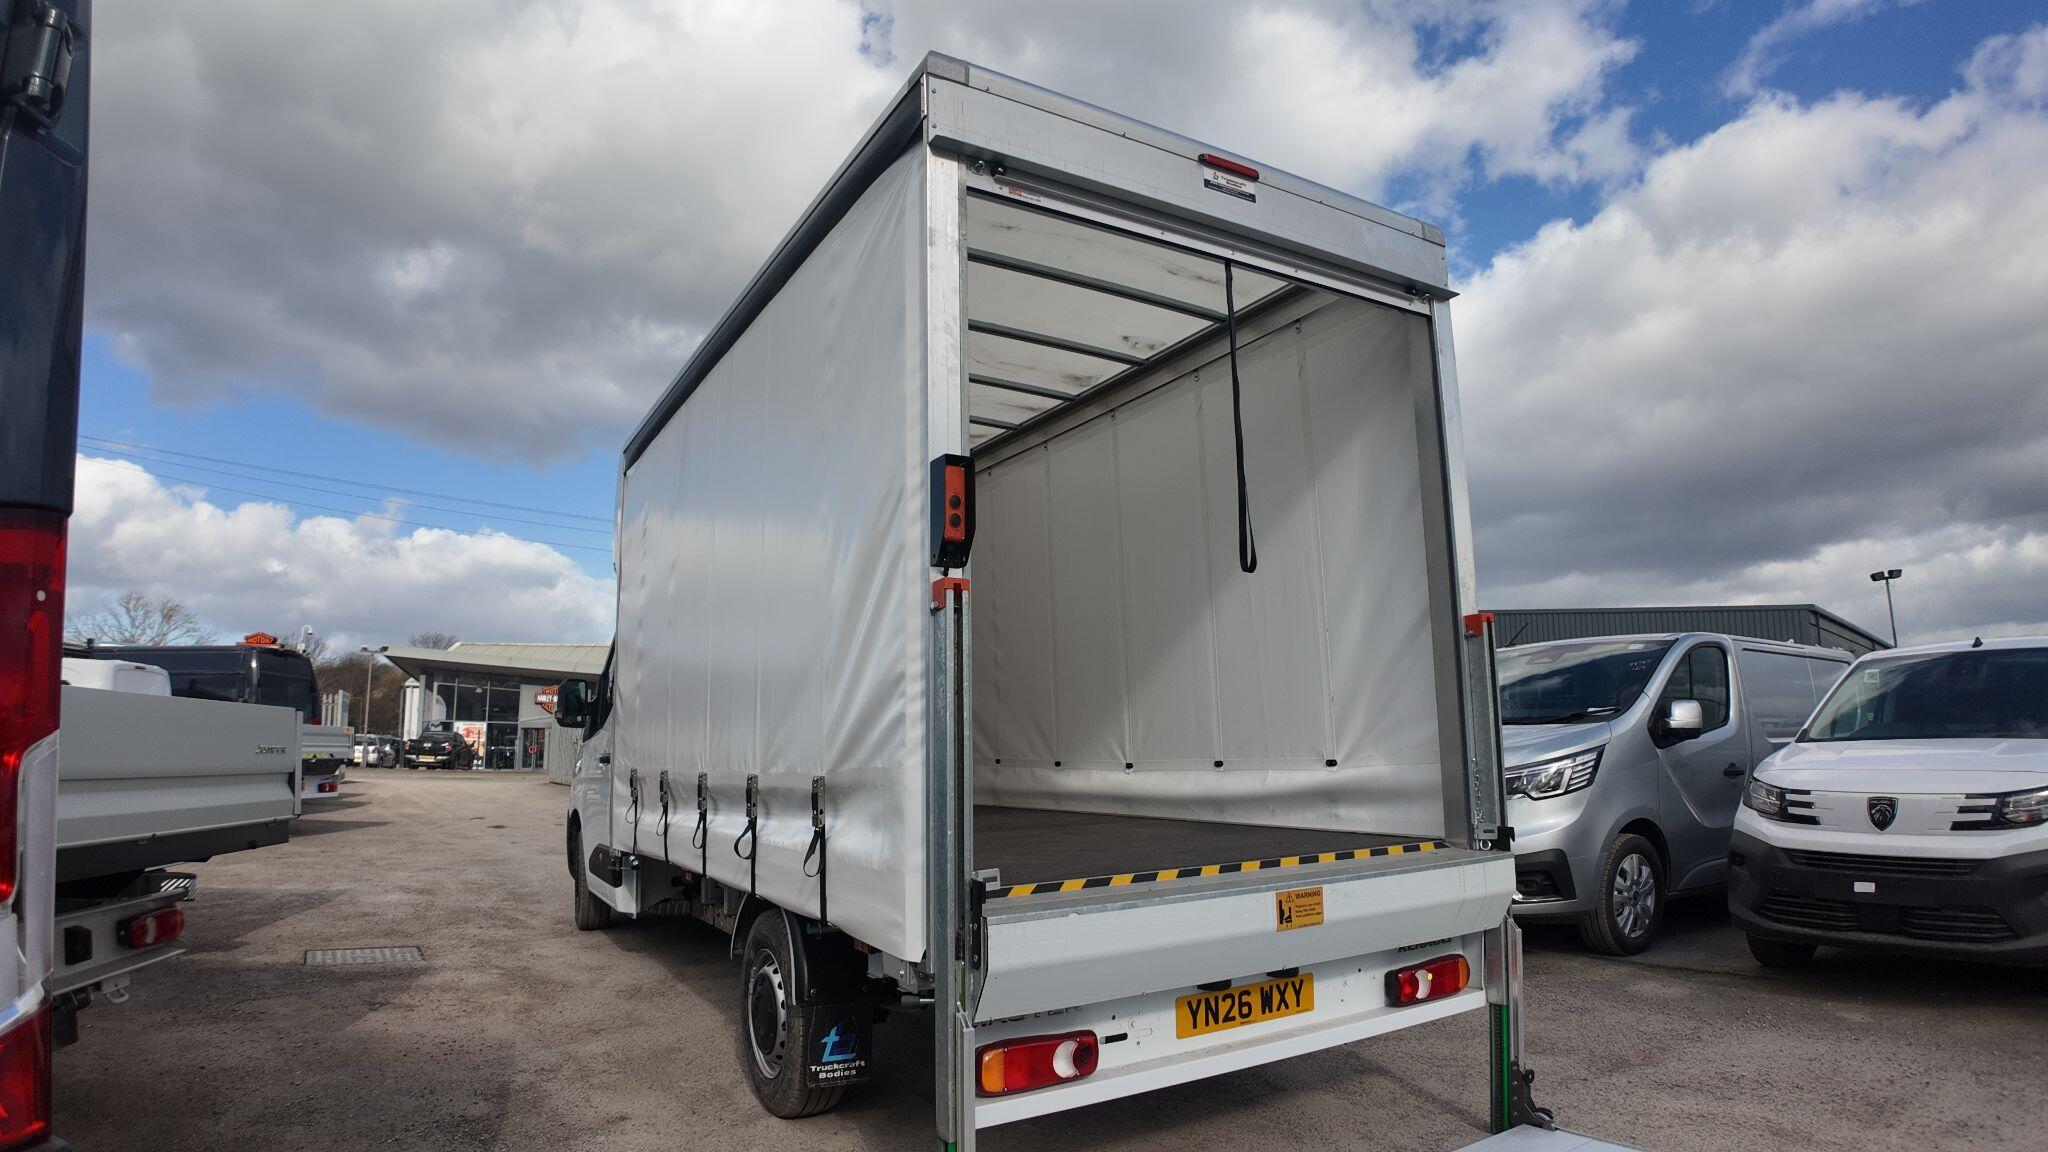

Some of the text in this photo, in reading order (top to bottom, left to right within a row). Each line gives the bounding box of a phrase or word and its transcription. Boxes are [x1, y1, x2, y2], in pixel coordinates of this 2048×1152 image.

[1295, 890, 1321, 899] WARNING
[1187, 979, 1304, 1030] YN26 WXY
[810, 1060, 866, 1072] Truckcraft
[818, 1069, 857, 1079] Bodies
